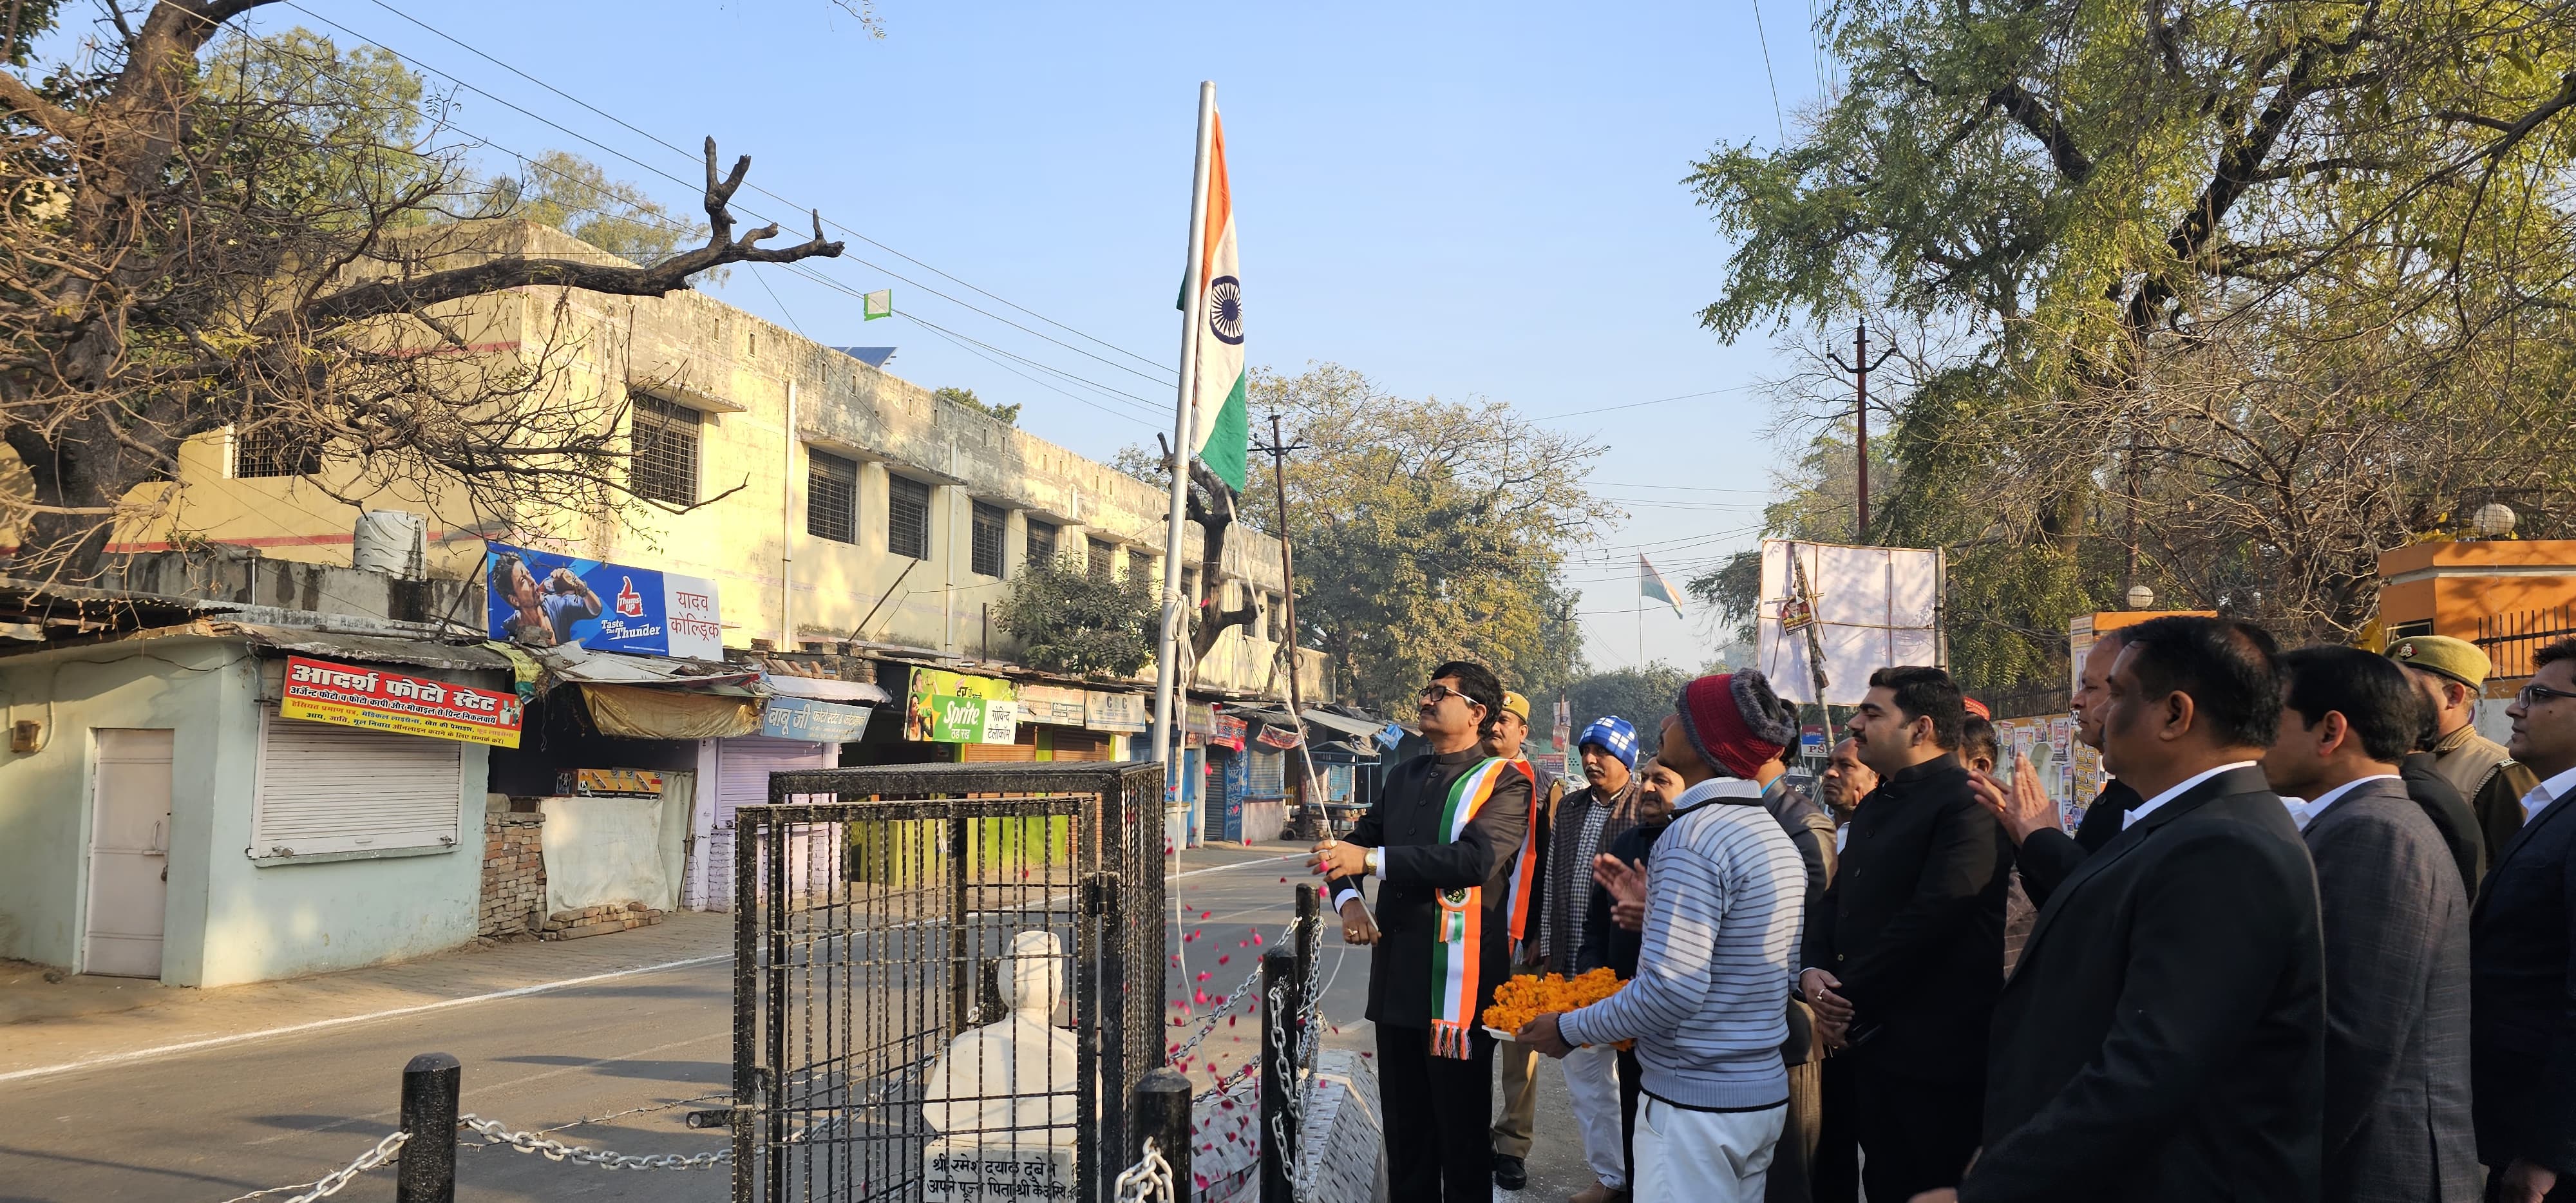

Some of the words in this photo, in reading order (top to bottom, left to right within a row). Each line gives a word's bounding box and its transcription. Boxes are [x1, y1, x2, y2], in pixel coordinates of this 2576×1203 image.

[619, 596, 640, 607] Thums
[676, 591, 708, 612] यादव
[601, 620, 624, 629] Taste
[608, 623, 661, 640] Thunder
[669, 611, 719, 641] कोल्ड्रिंक
[291, 664, 380, 694] आदर्श
[385, 677, 448, 704] फोटो
[453, 688, 498, 712] स्टेट
[319, 690, 338, 700] फोटो
[349, 696, 368, 705] फोटो
[370, 699, 388, 708] कापी
[391, 701, 405, 710] और
[437, 707, 444, 716] से
[768, 707, 793, 735] बाबू
[793, 703, 811, 730] जी
[943, 701, 980, 730] Sprite
[933, 1153, 947, 1172] श्री
[1016, 1179, 1032, 1198] श्री
